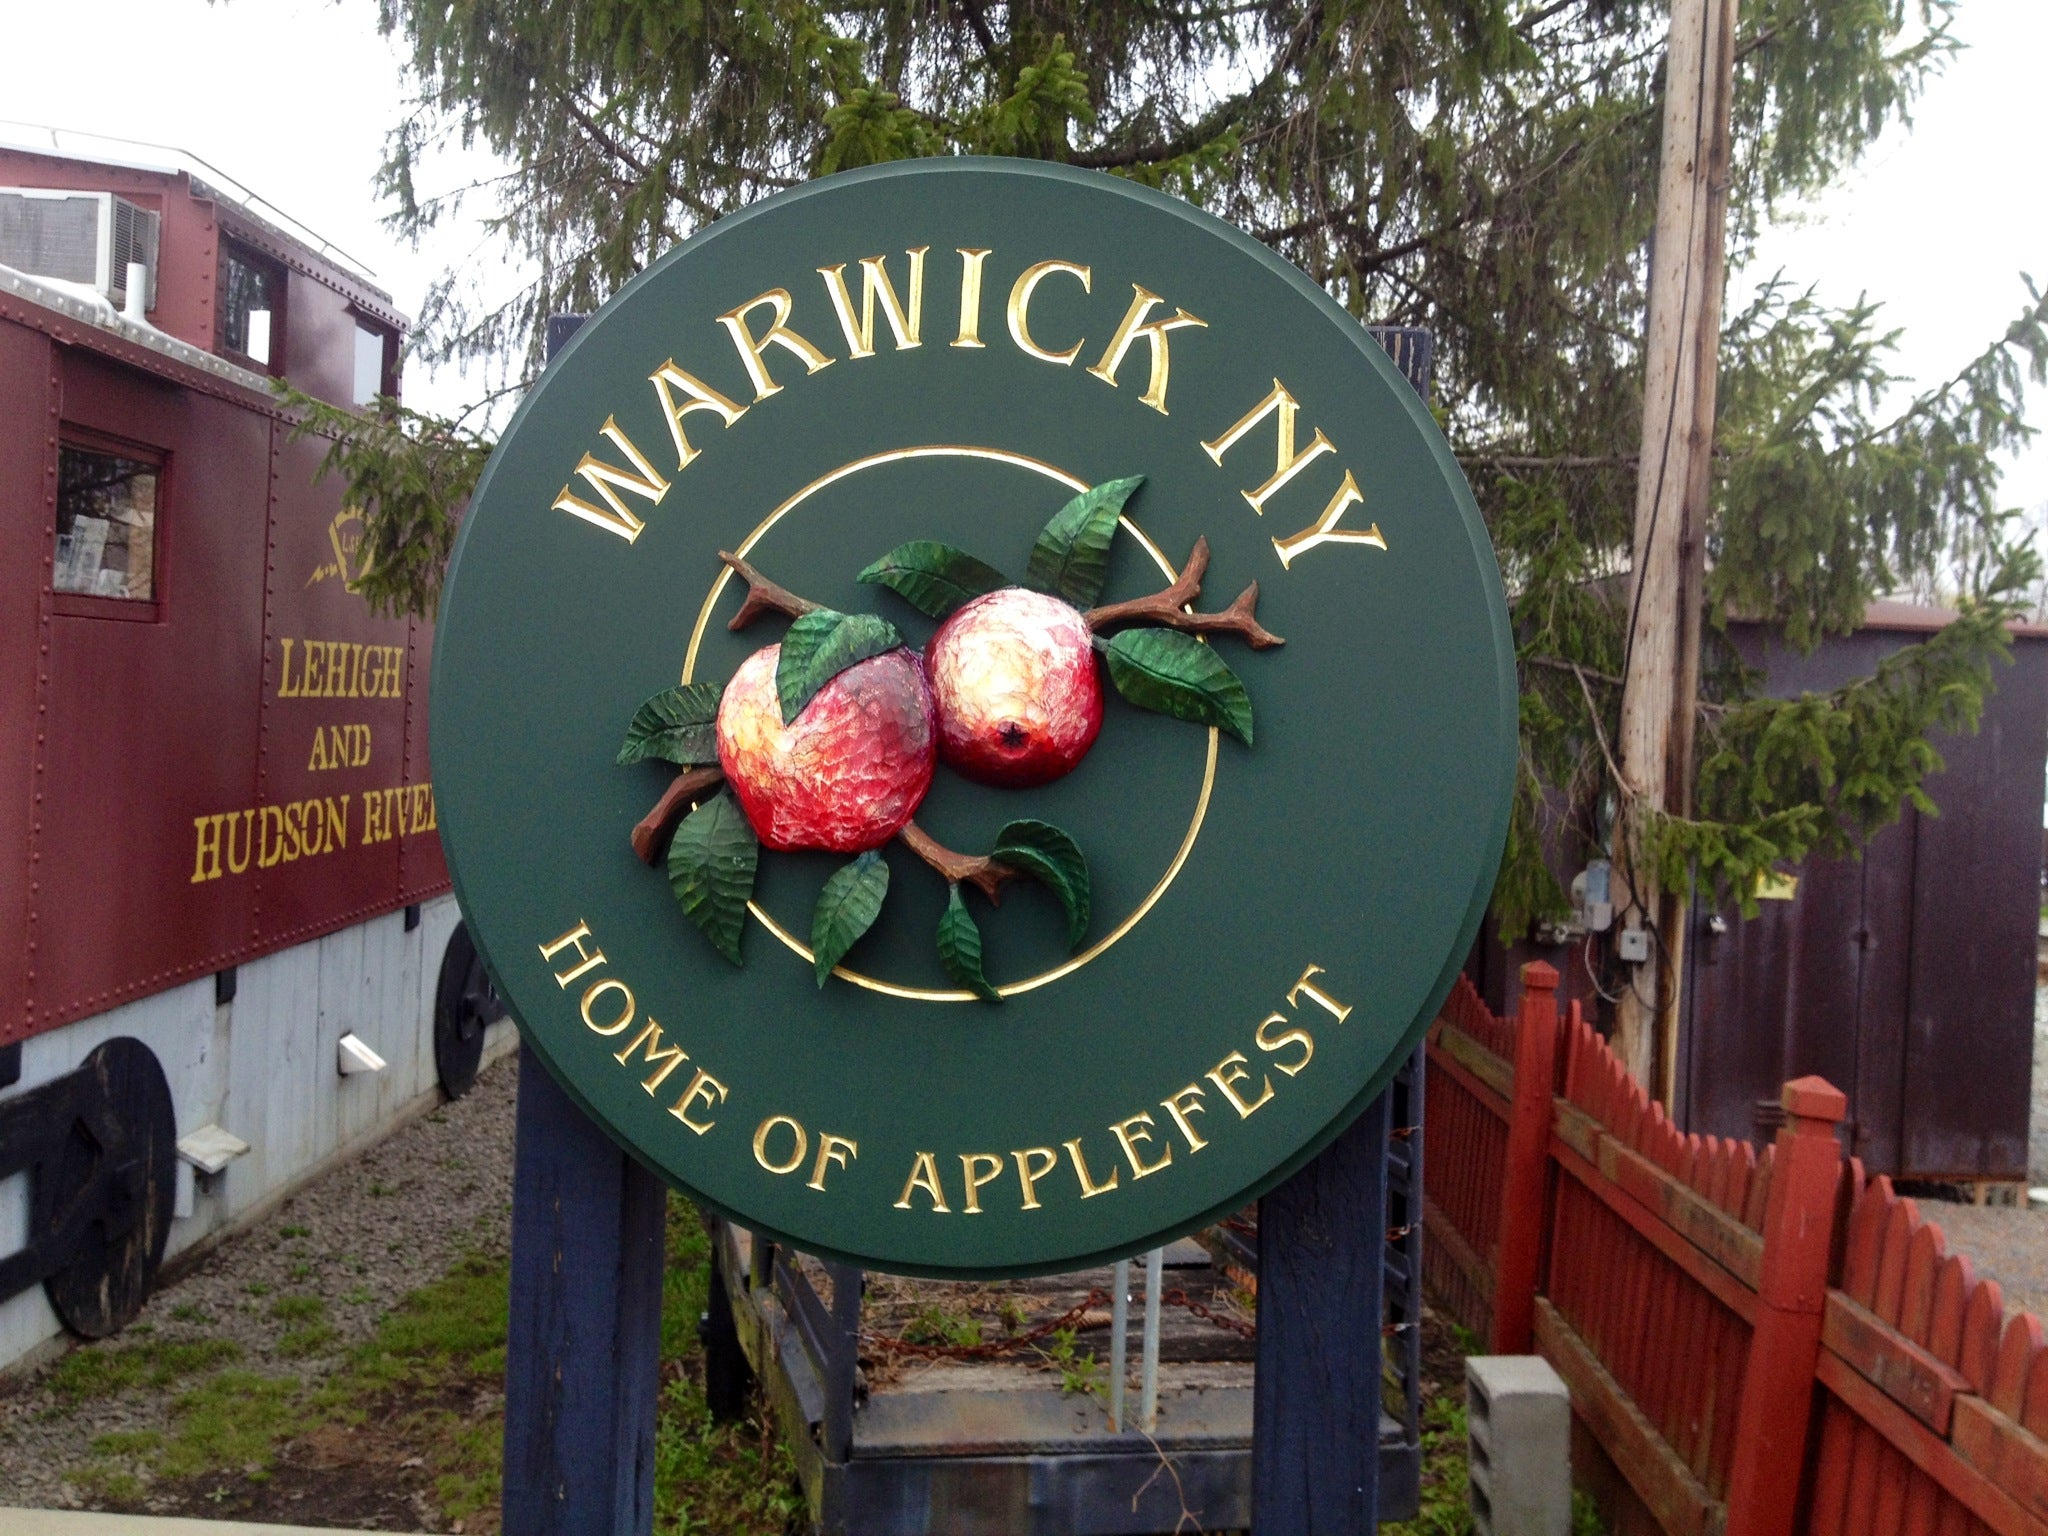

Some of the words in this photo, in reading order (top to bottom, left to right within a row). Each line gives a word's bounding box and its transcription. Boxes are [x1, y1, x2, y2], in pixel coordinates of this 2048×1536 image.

[551, 246, 1208, 545] WARWICK
[1200, 377, 1389, 570] NY
[278, 638, 403, 698] LEHIGH
[308, 724, 371, 771] AND
[191, 795, 350, 883] HUDSON
[538, 919, 729, 1136] HOME
[752, 1114, 858, 1191] OF
[893, 963, 1353, 1214] APPLEFEST
